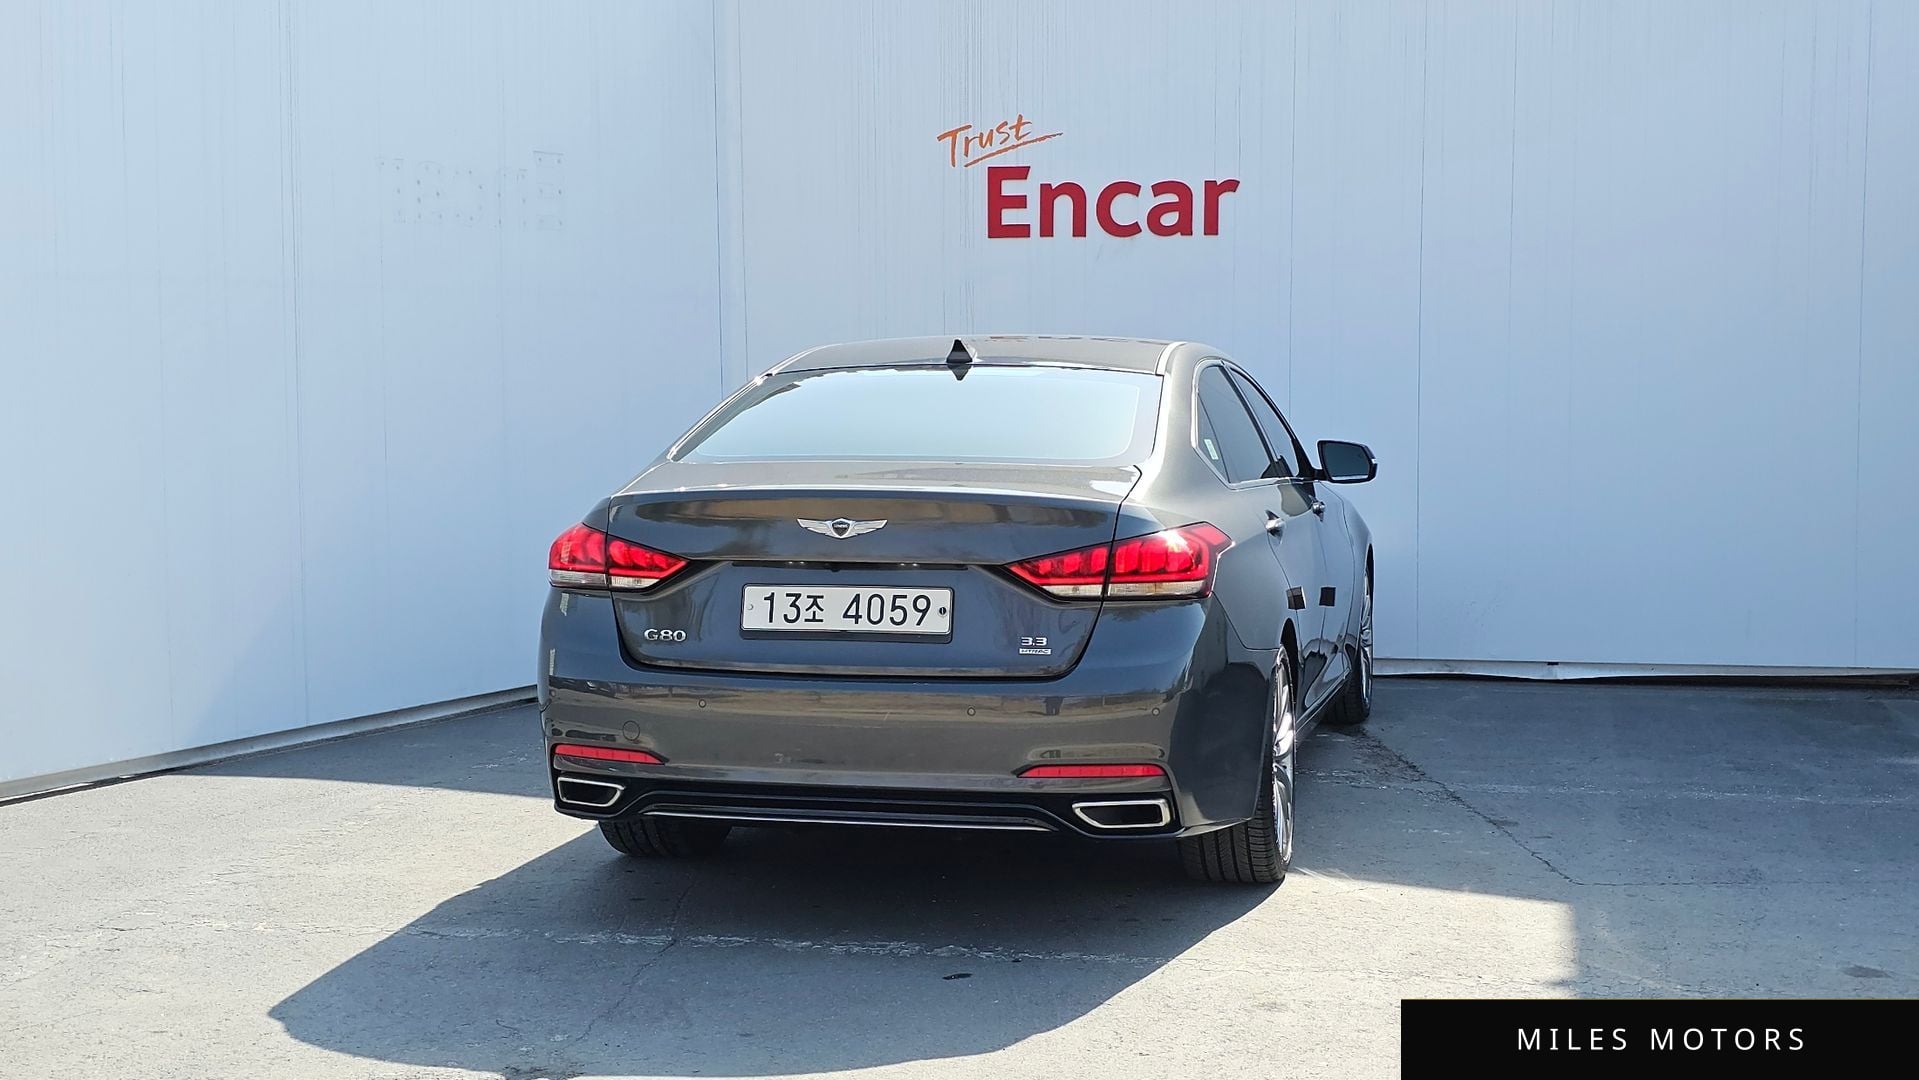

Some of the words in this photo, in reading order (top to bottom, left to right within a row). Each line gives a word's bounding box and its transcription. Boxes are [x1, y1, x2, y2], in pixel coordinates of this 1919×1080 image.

[937, 114, 1032, 168] Trust
[987, 165, 1241, 239] Encar
[763, 592, 825, 624] 13조
[842, 593, 932, 626] 4059
[644, 628, 687, 642] G80
[1021, 636, 1048, 646] 3.3
